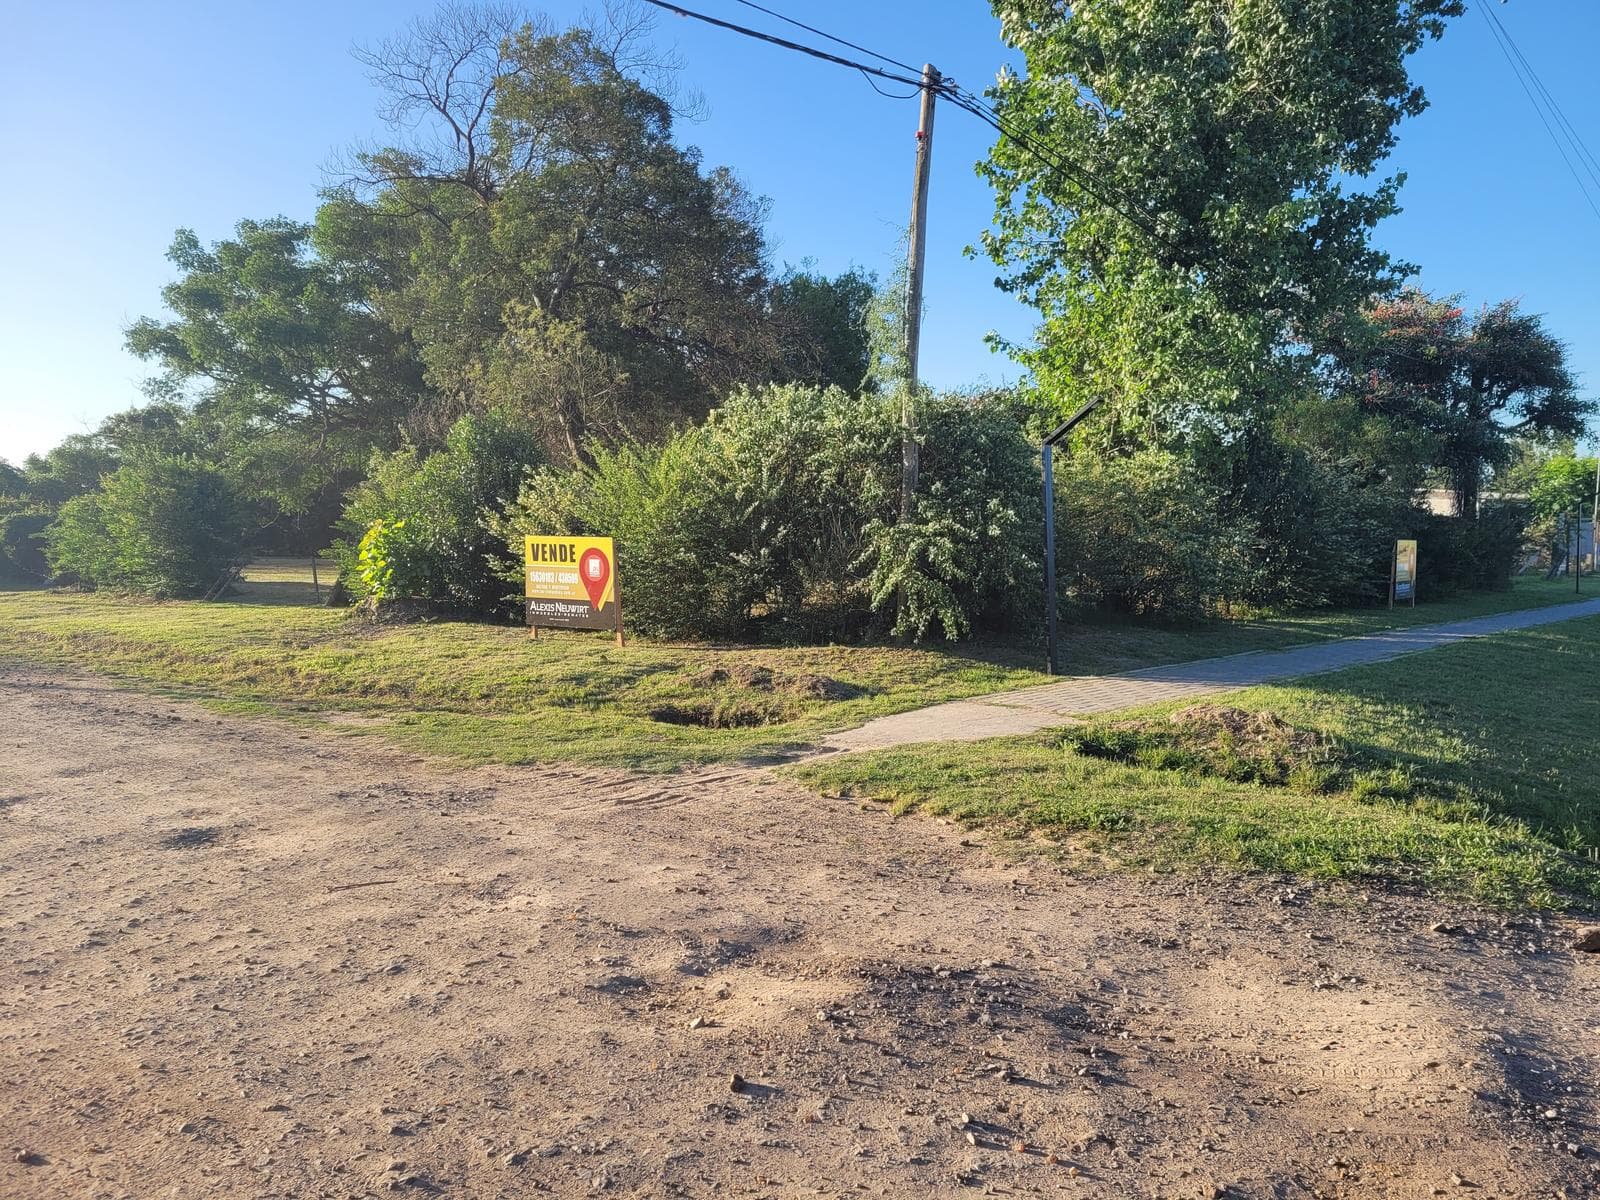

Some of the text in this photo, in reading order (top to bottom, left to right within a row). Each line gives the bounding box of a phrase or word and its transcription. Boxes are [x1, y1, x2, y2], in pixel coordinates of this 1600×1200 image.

[531, 544, 576, 562] VENDE
[530, 600, 590, 614] ALEXIS NEUWIRT
